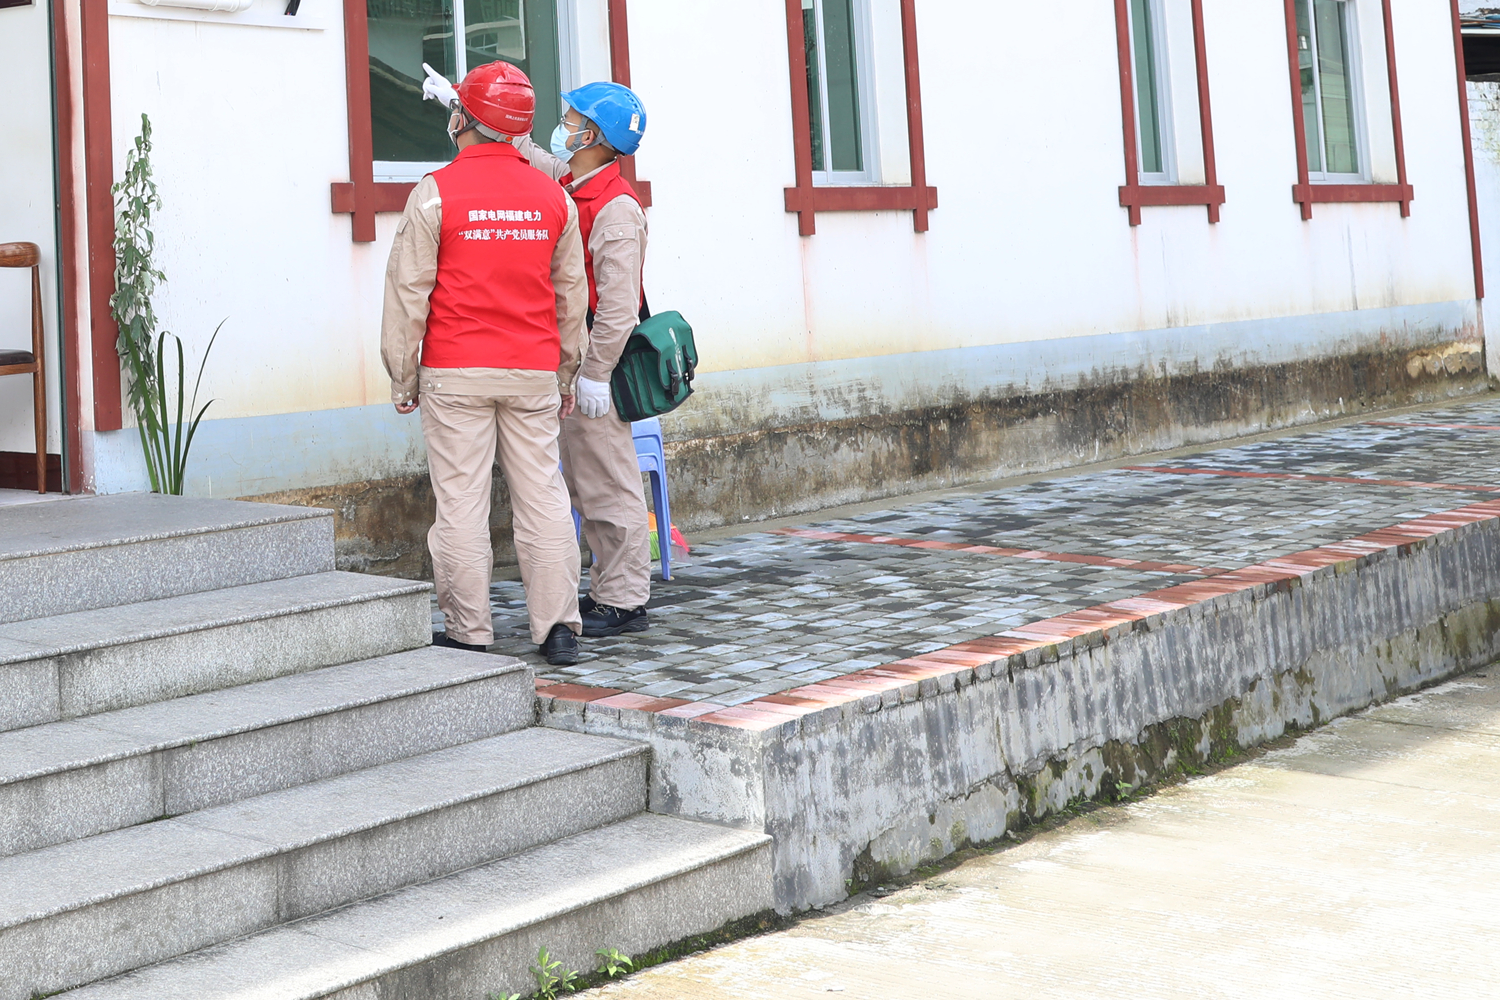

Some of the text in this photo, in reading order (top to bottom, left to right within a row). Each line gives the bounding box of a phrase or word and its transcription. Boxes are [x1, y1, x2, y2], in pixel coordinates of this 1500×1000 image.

[468, 209, 542, 222] 国家电网福建电力
